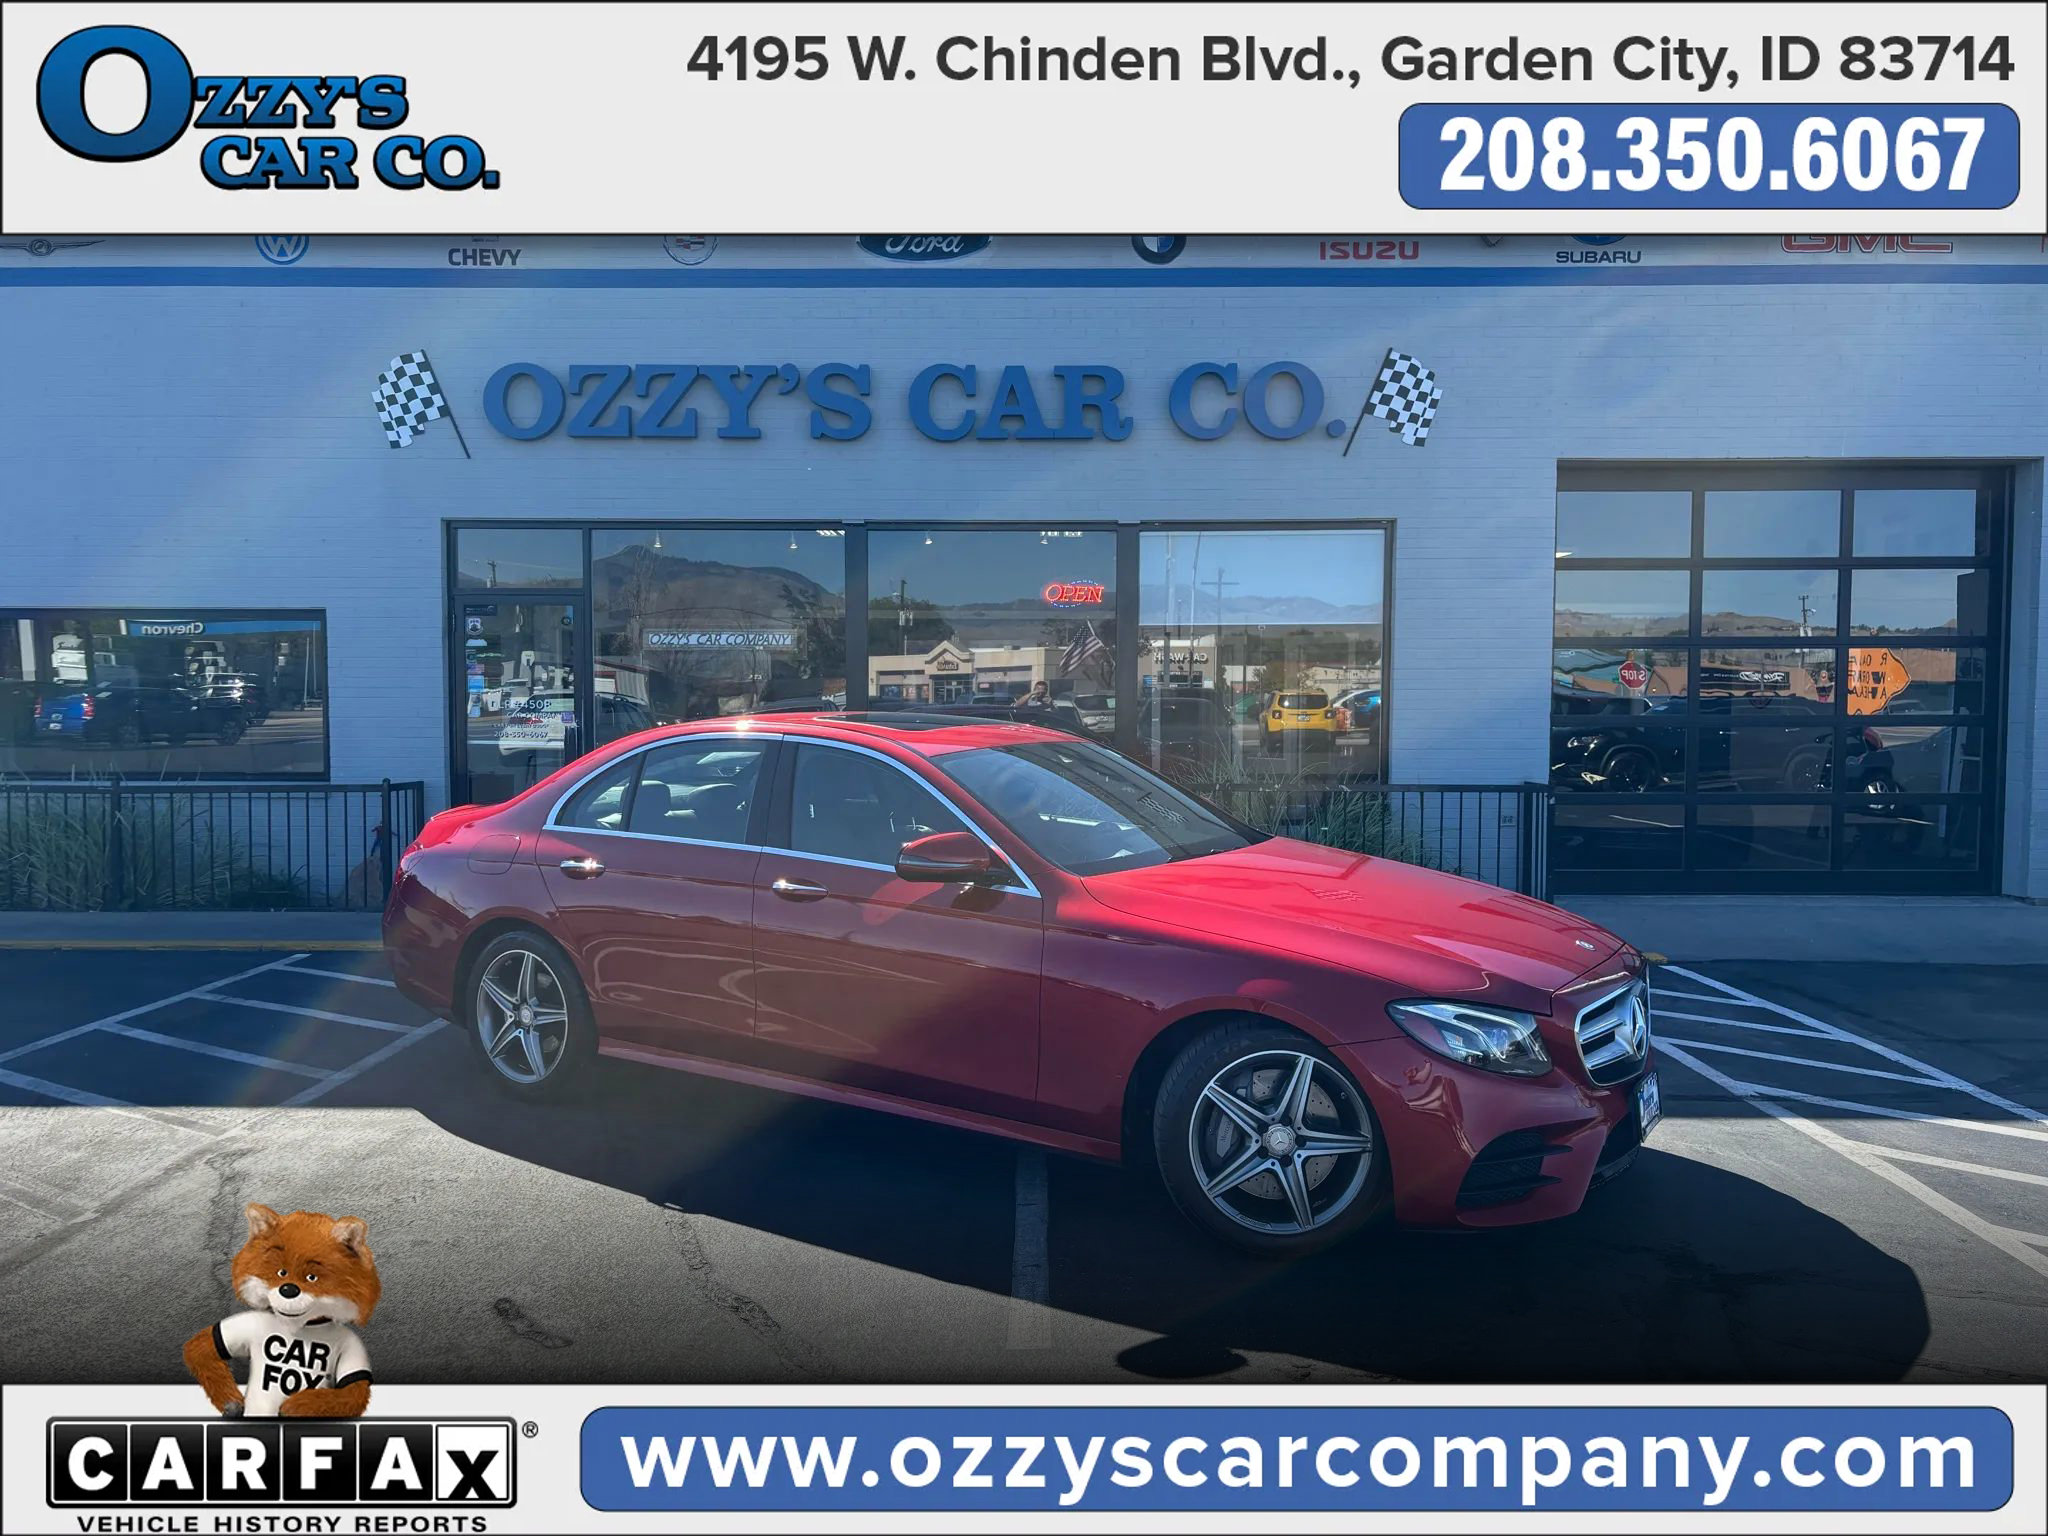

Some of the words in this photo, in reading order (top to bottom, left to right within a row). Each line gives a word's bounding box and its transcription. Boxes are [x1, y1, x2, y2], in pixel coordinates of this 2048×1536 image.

[448, 248, 521, 266] CHEVY
[1319, 241, 1419, 260] ISUZU
[1556, 251, 1641, 264] SUBARU
[483, 362, 872, 441] OZZY'S
[908, 363, 1134, 442] CAR
[1169, 360, 1346, 440] CO.
[1046, 584, 1104, 602] OPEN
[650, 633, 691, 645] OZZY'S
[696, 633, 721, 645] CAR
[725, 633, 789, 645] COMPANY
